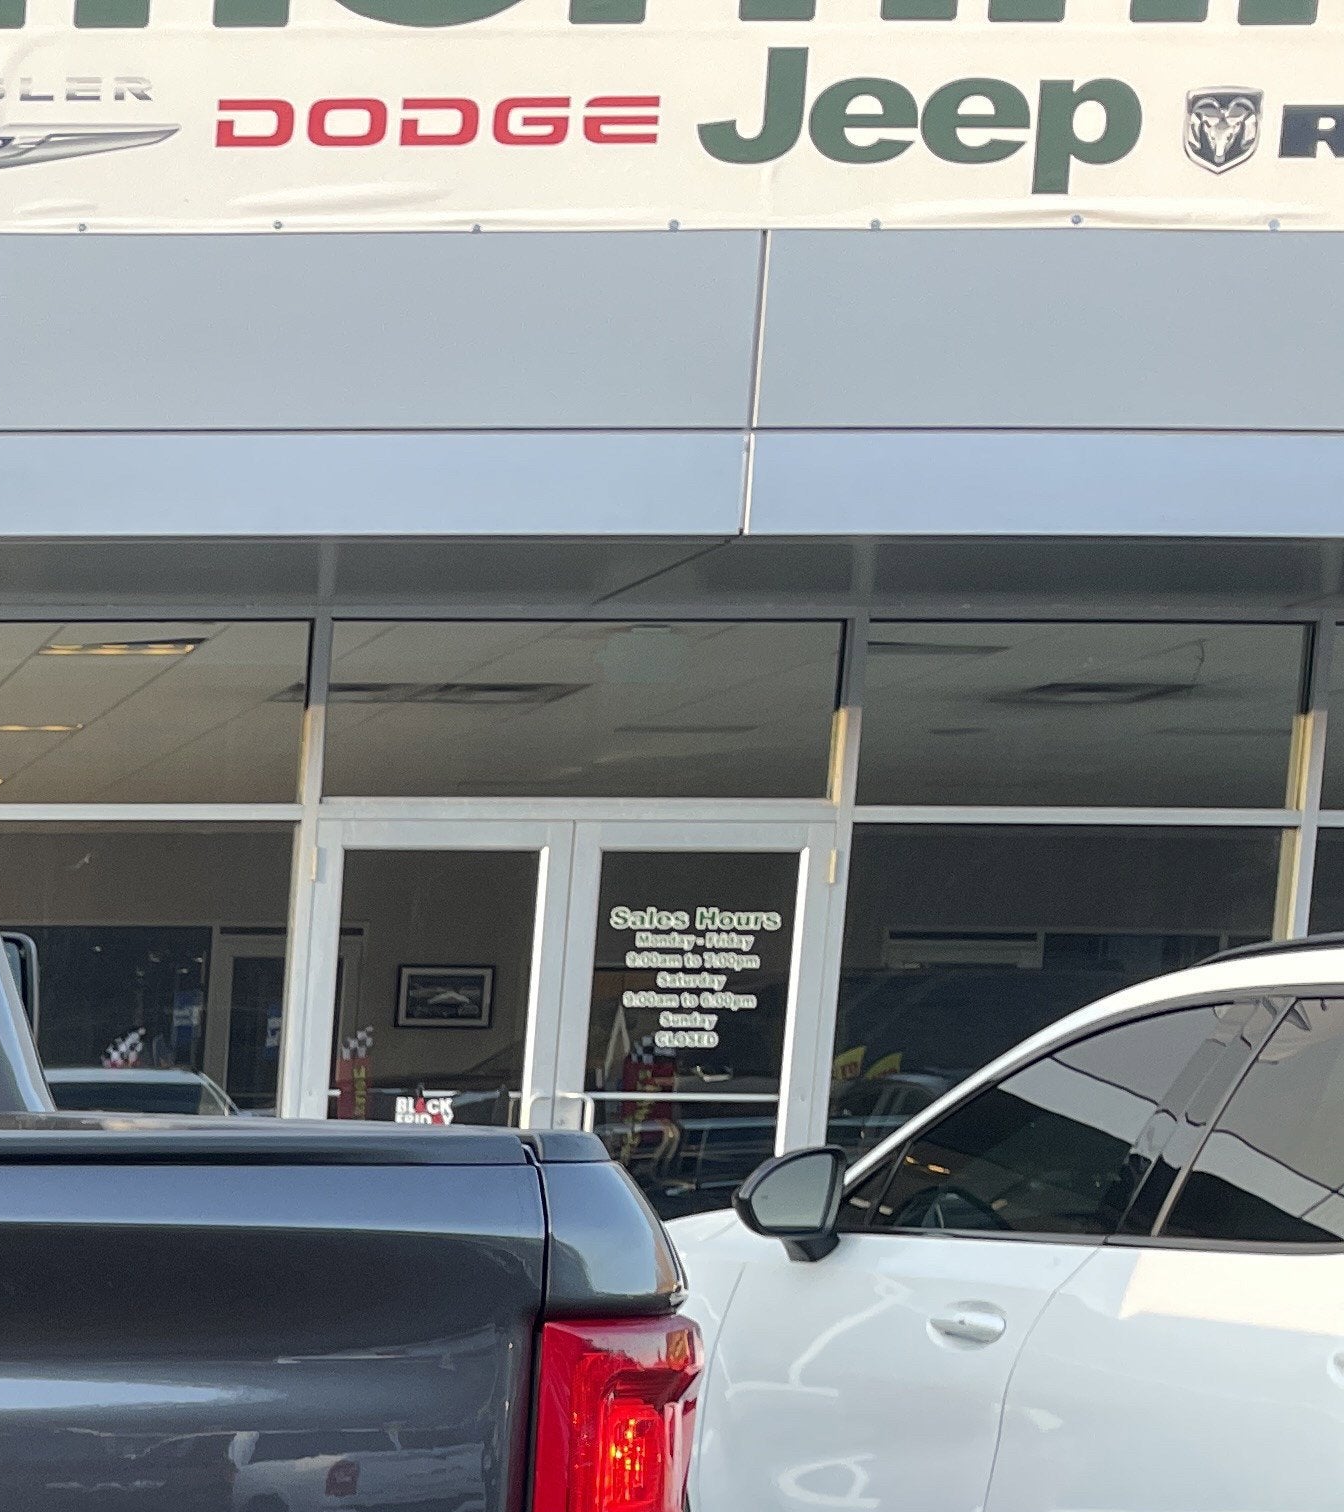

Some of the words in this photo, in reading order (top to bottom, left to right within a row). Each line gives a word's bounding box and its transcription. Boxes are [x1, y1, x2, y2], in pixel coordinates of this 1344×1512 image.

[215, 94, 661, 147] DODGE
[697, 47, 1143, 194] Jeep
[610, 906, 690, 930] Sales
[695, 906, 782, 931] Hours
[635, 931, 696, 950] Monday
[705, 932, 755, 951] Friday
[683, 952, 703, 969] to
[656, 971, 727, 991] Saturday
[680, 991, 699, 1009] to
[658, 1011, 718, 1030] Sunday
[654, 1030, 719, 1048] CLOSED
[395, 1096, 453, 1115] BLACK
